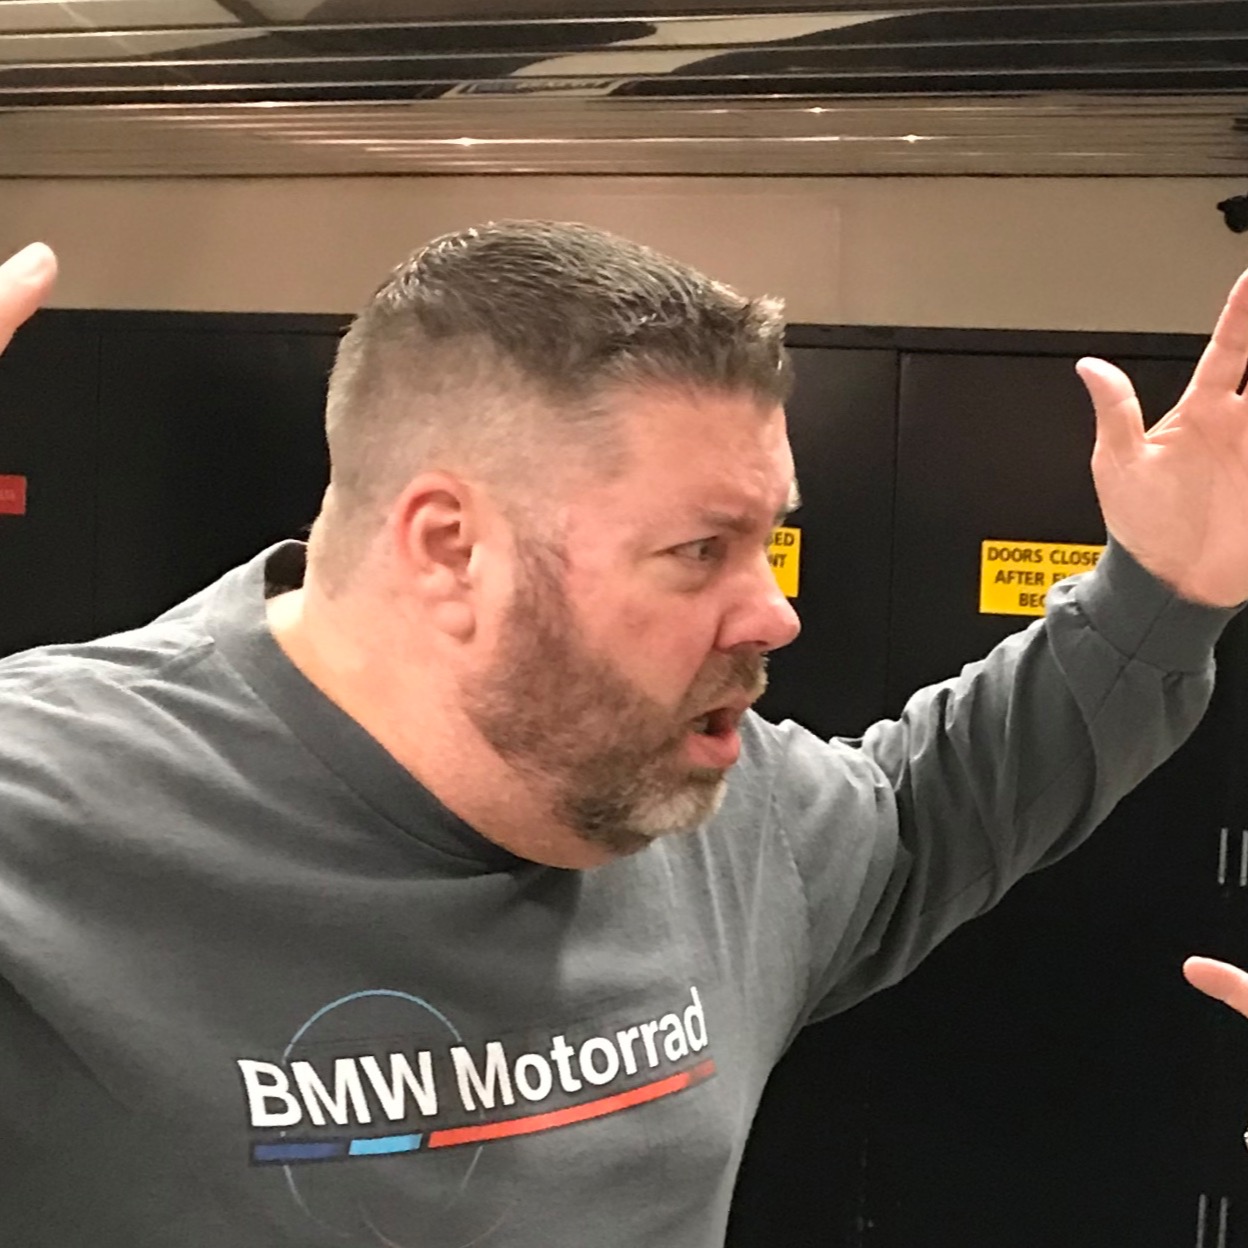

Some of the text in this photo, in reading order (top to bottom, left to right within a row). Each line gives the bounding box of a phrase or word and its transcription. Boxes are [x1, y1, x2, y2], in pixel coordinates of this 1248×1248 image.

[987, 547, 1100, 566] DOORS CLOSE
[994, 570, 1045, 586] AFTER
[237, 986, 708, 1127] BMW Motorrad
